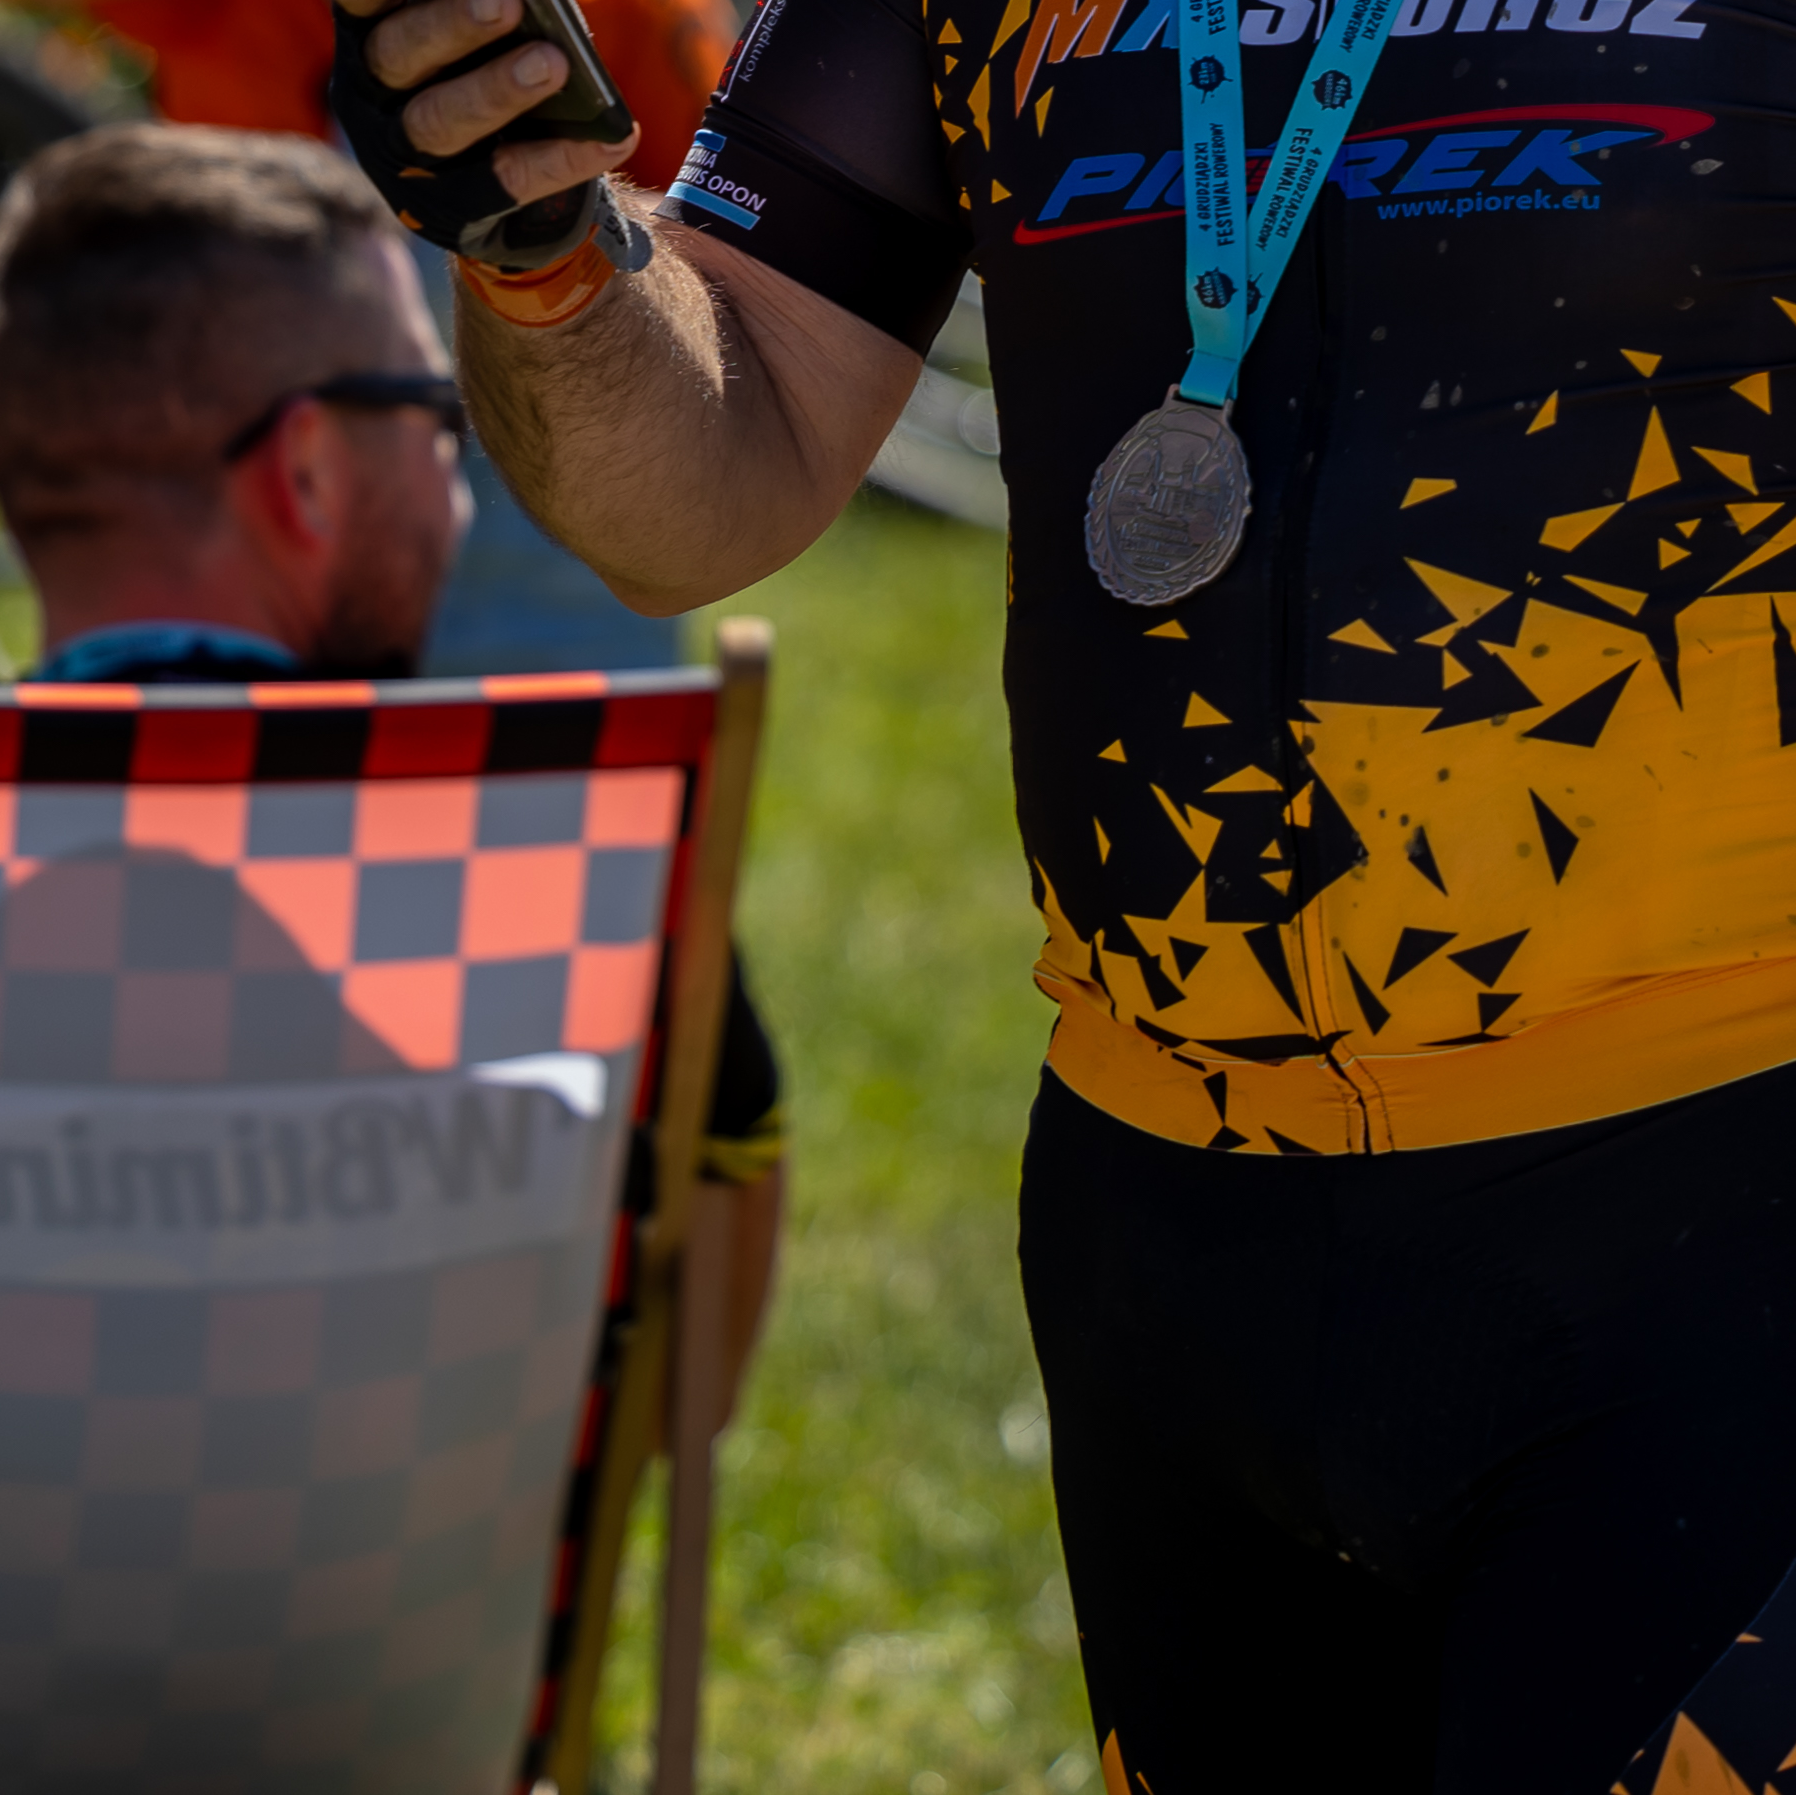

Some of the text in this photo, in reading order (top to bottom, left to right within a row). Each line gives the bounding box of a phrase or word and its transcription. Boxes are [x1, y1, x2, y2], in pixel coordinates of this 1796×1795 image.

[1309, 144, 1324, 156] 4
[707, 174, 768, 213] OPON
[1209, 123, 1234, 246] FESTIWAL ROWEROWY
[1255, 129, 1313, 250] FESTIWAL ROWEROWY
[1377, 188, 1602, 221] www.piorek.eu
